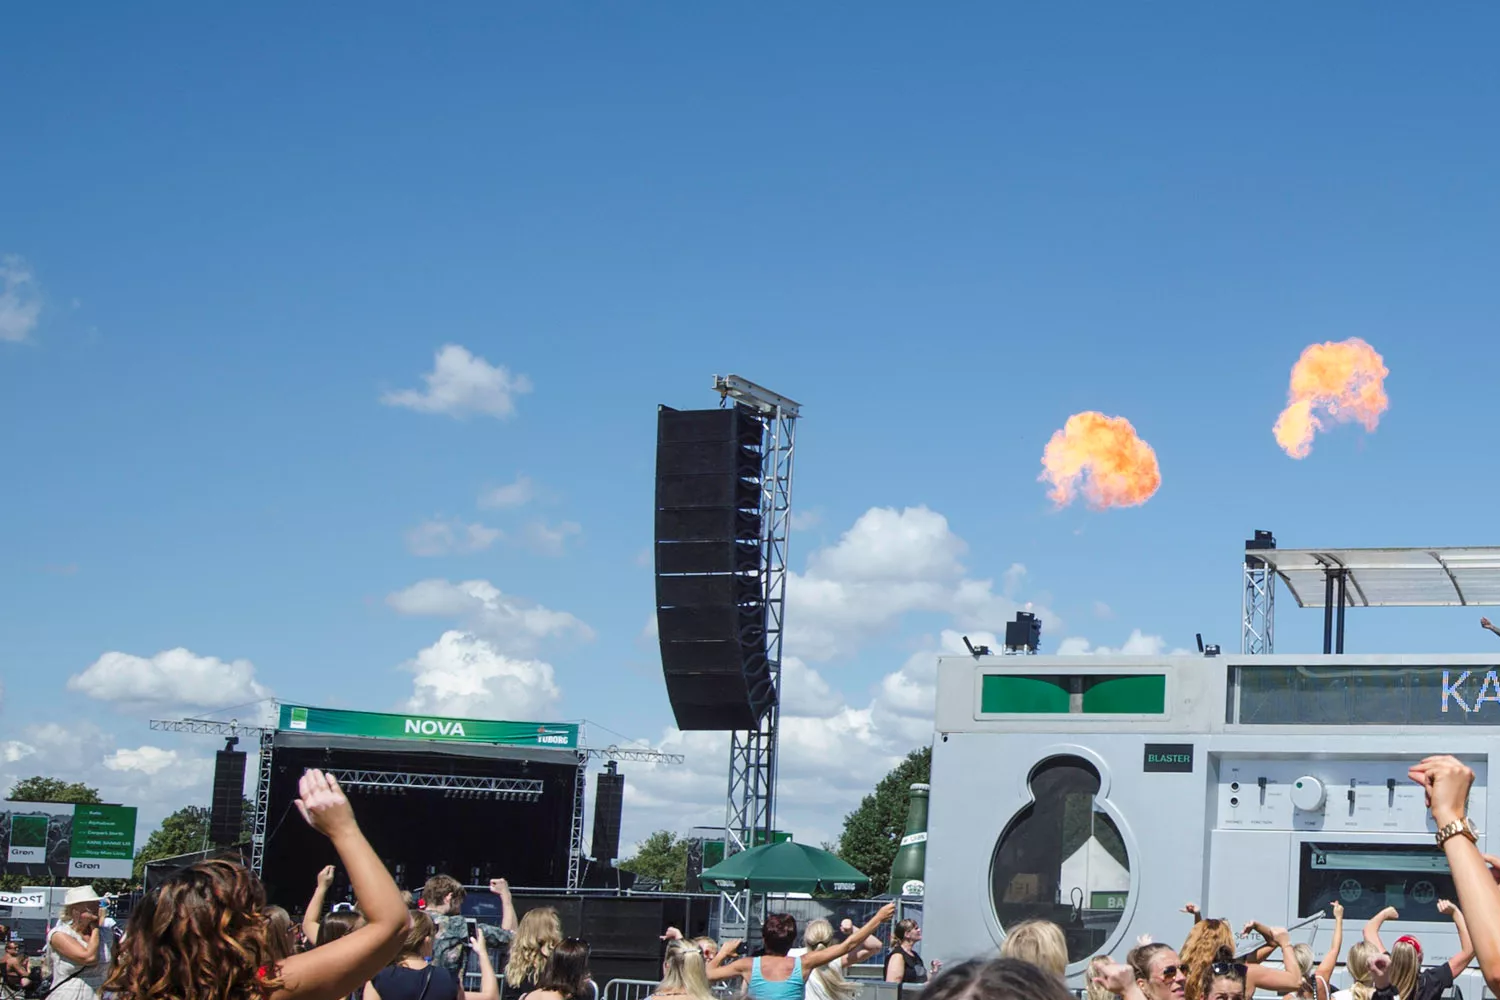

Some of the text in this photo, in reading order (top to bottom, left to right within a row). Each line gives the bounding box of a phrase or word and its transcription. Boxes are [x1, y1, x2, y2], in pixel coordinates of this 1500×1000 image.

[404, 719, 466, 736] NOVA
[537, 736, 569, 744] TUBORG
[1148, 754, 1190, 763] BLASTER
[11, 848, 35, 856] Grøn
[74, 861, 101, 870] Grøn
